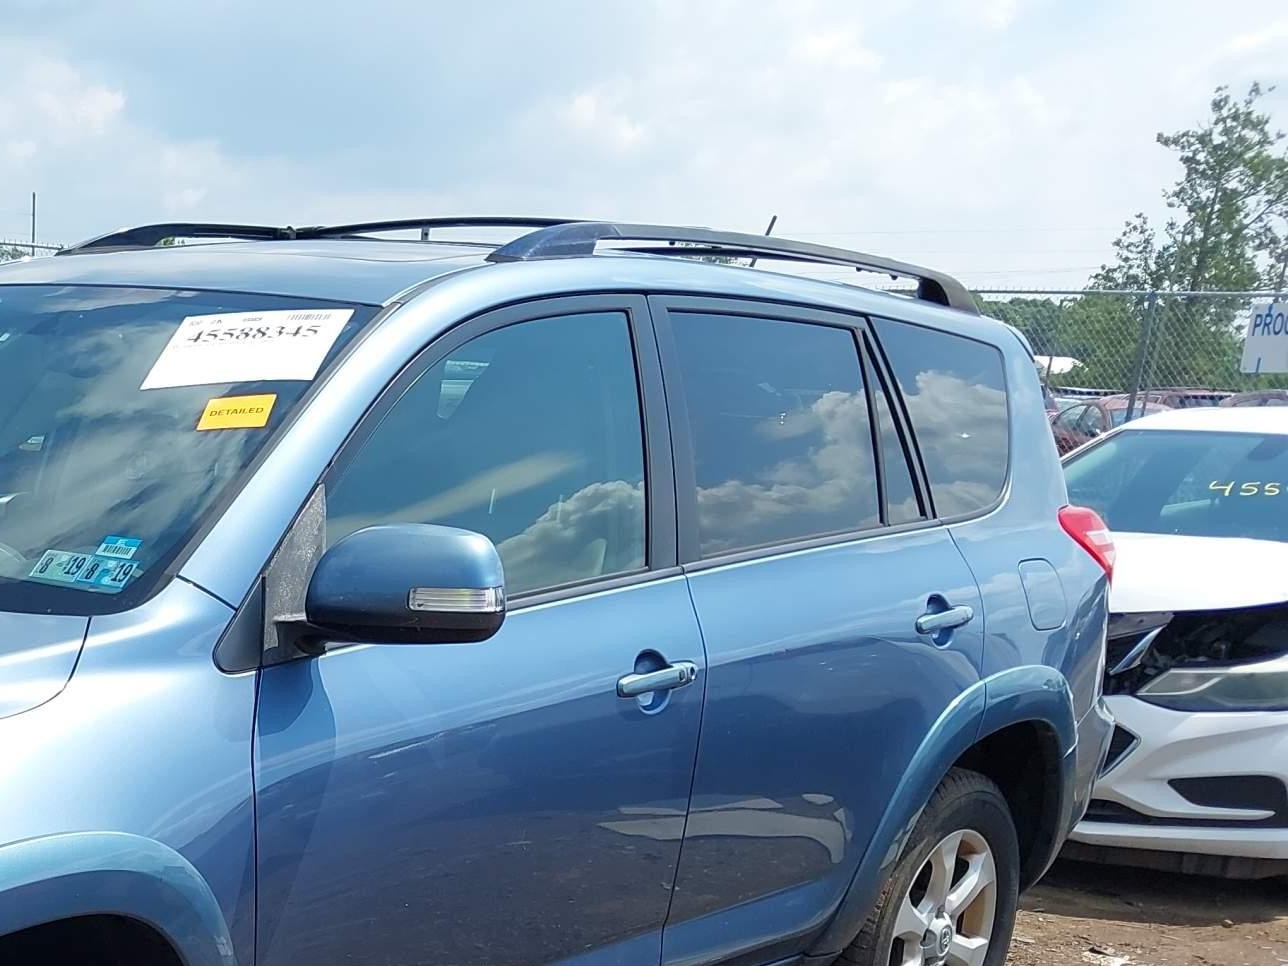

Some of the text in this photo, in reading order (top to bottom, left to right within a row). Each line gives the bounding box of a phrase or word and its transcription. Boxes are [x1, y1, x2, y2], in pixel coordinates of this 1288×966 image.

[186, 325, 321, 343] 45588345
[209, 407, 264, 416] DETAILED
[1209, 480, 1288, 496] 455
[38, 556, 87, 576] 8 19
[85, 563, 132, 582] 8 19
